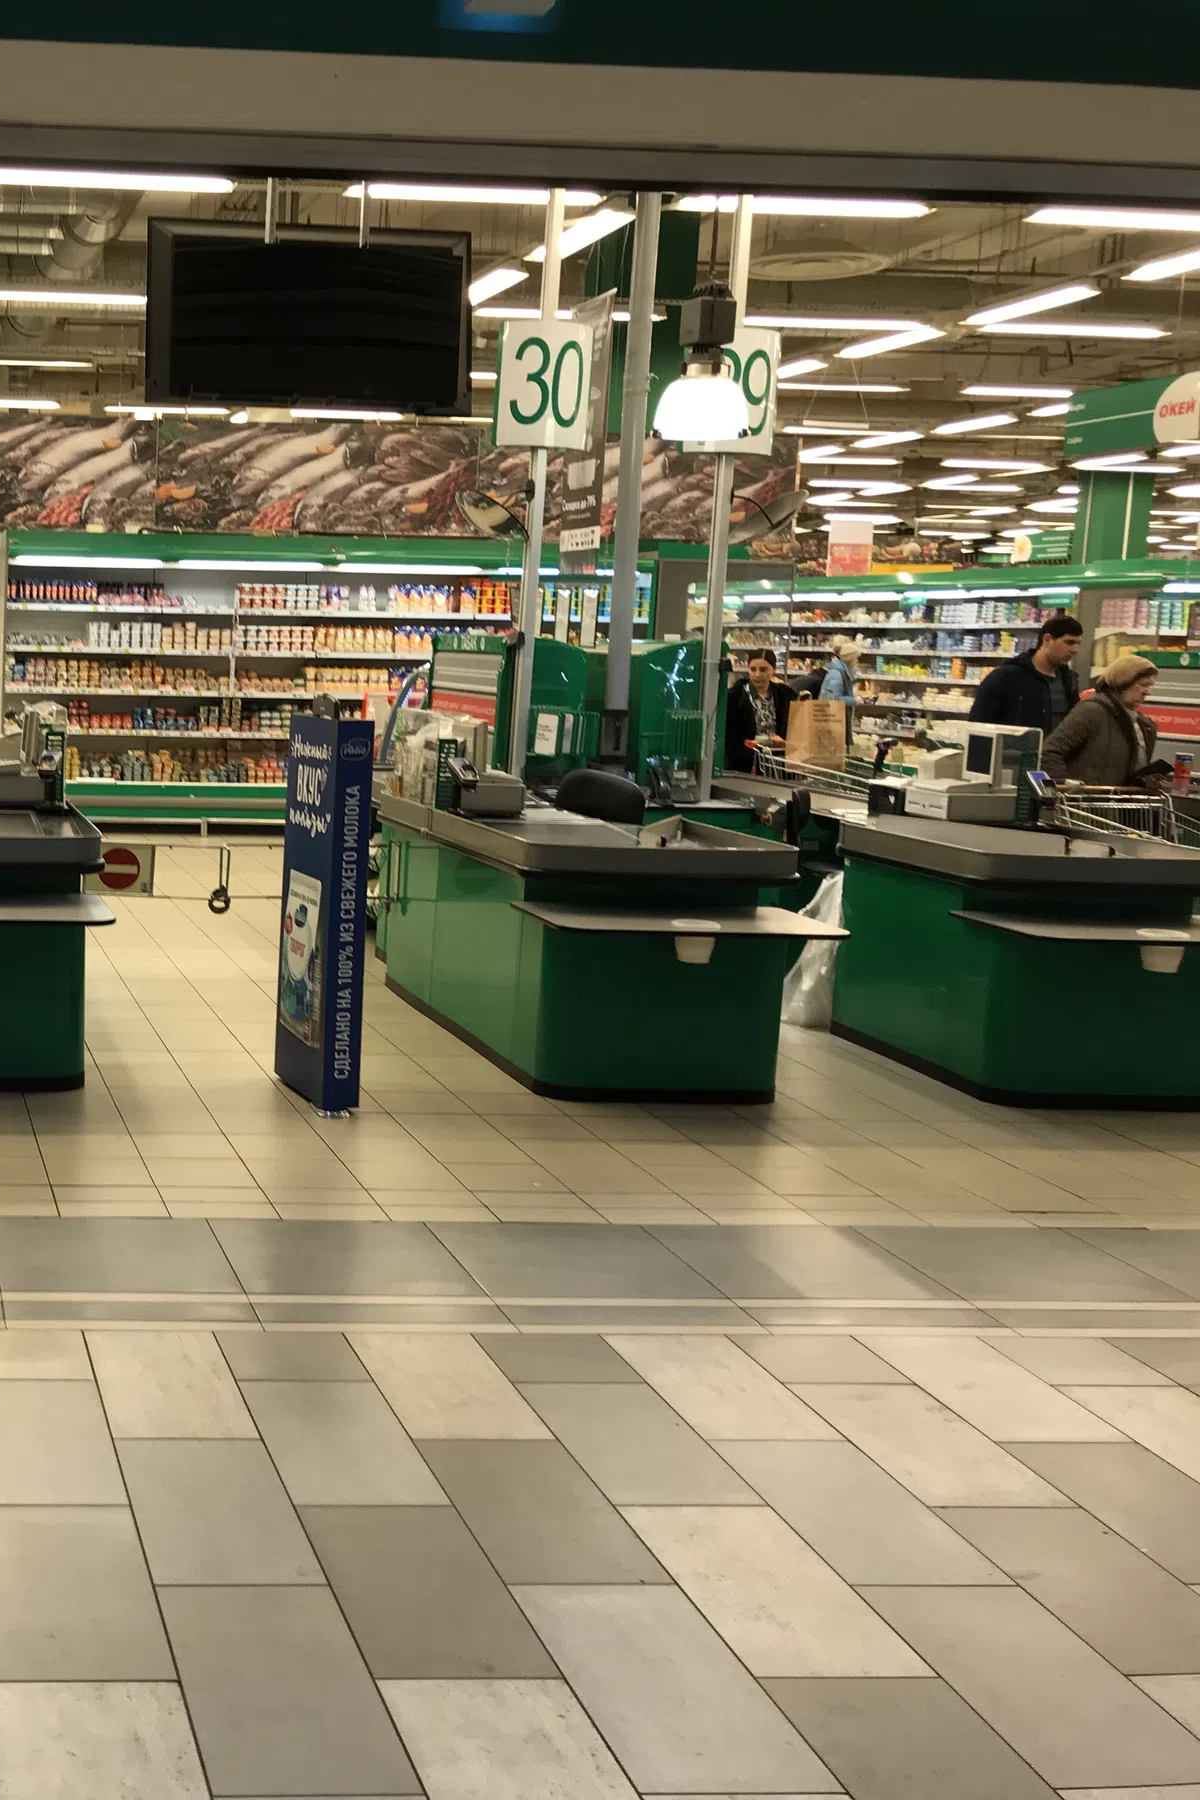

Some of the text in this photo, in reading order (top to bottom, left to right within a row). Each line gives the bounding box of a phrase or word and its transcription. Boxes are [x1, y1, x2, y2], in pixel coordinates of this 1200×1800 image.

[509, 336, 584, 428] 30
[293, 733, 329, 760] Нежный
[296, 763, 322, 808] ВКУС
[333, 784, 361, 1080] СДЕЛАНО НА 100% ИЗ СВЕЖЕГО МОЛОКА
